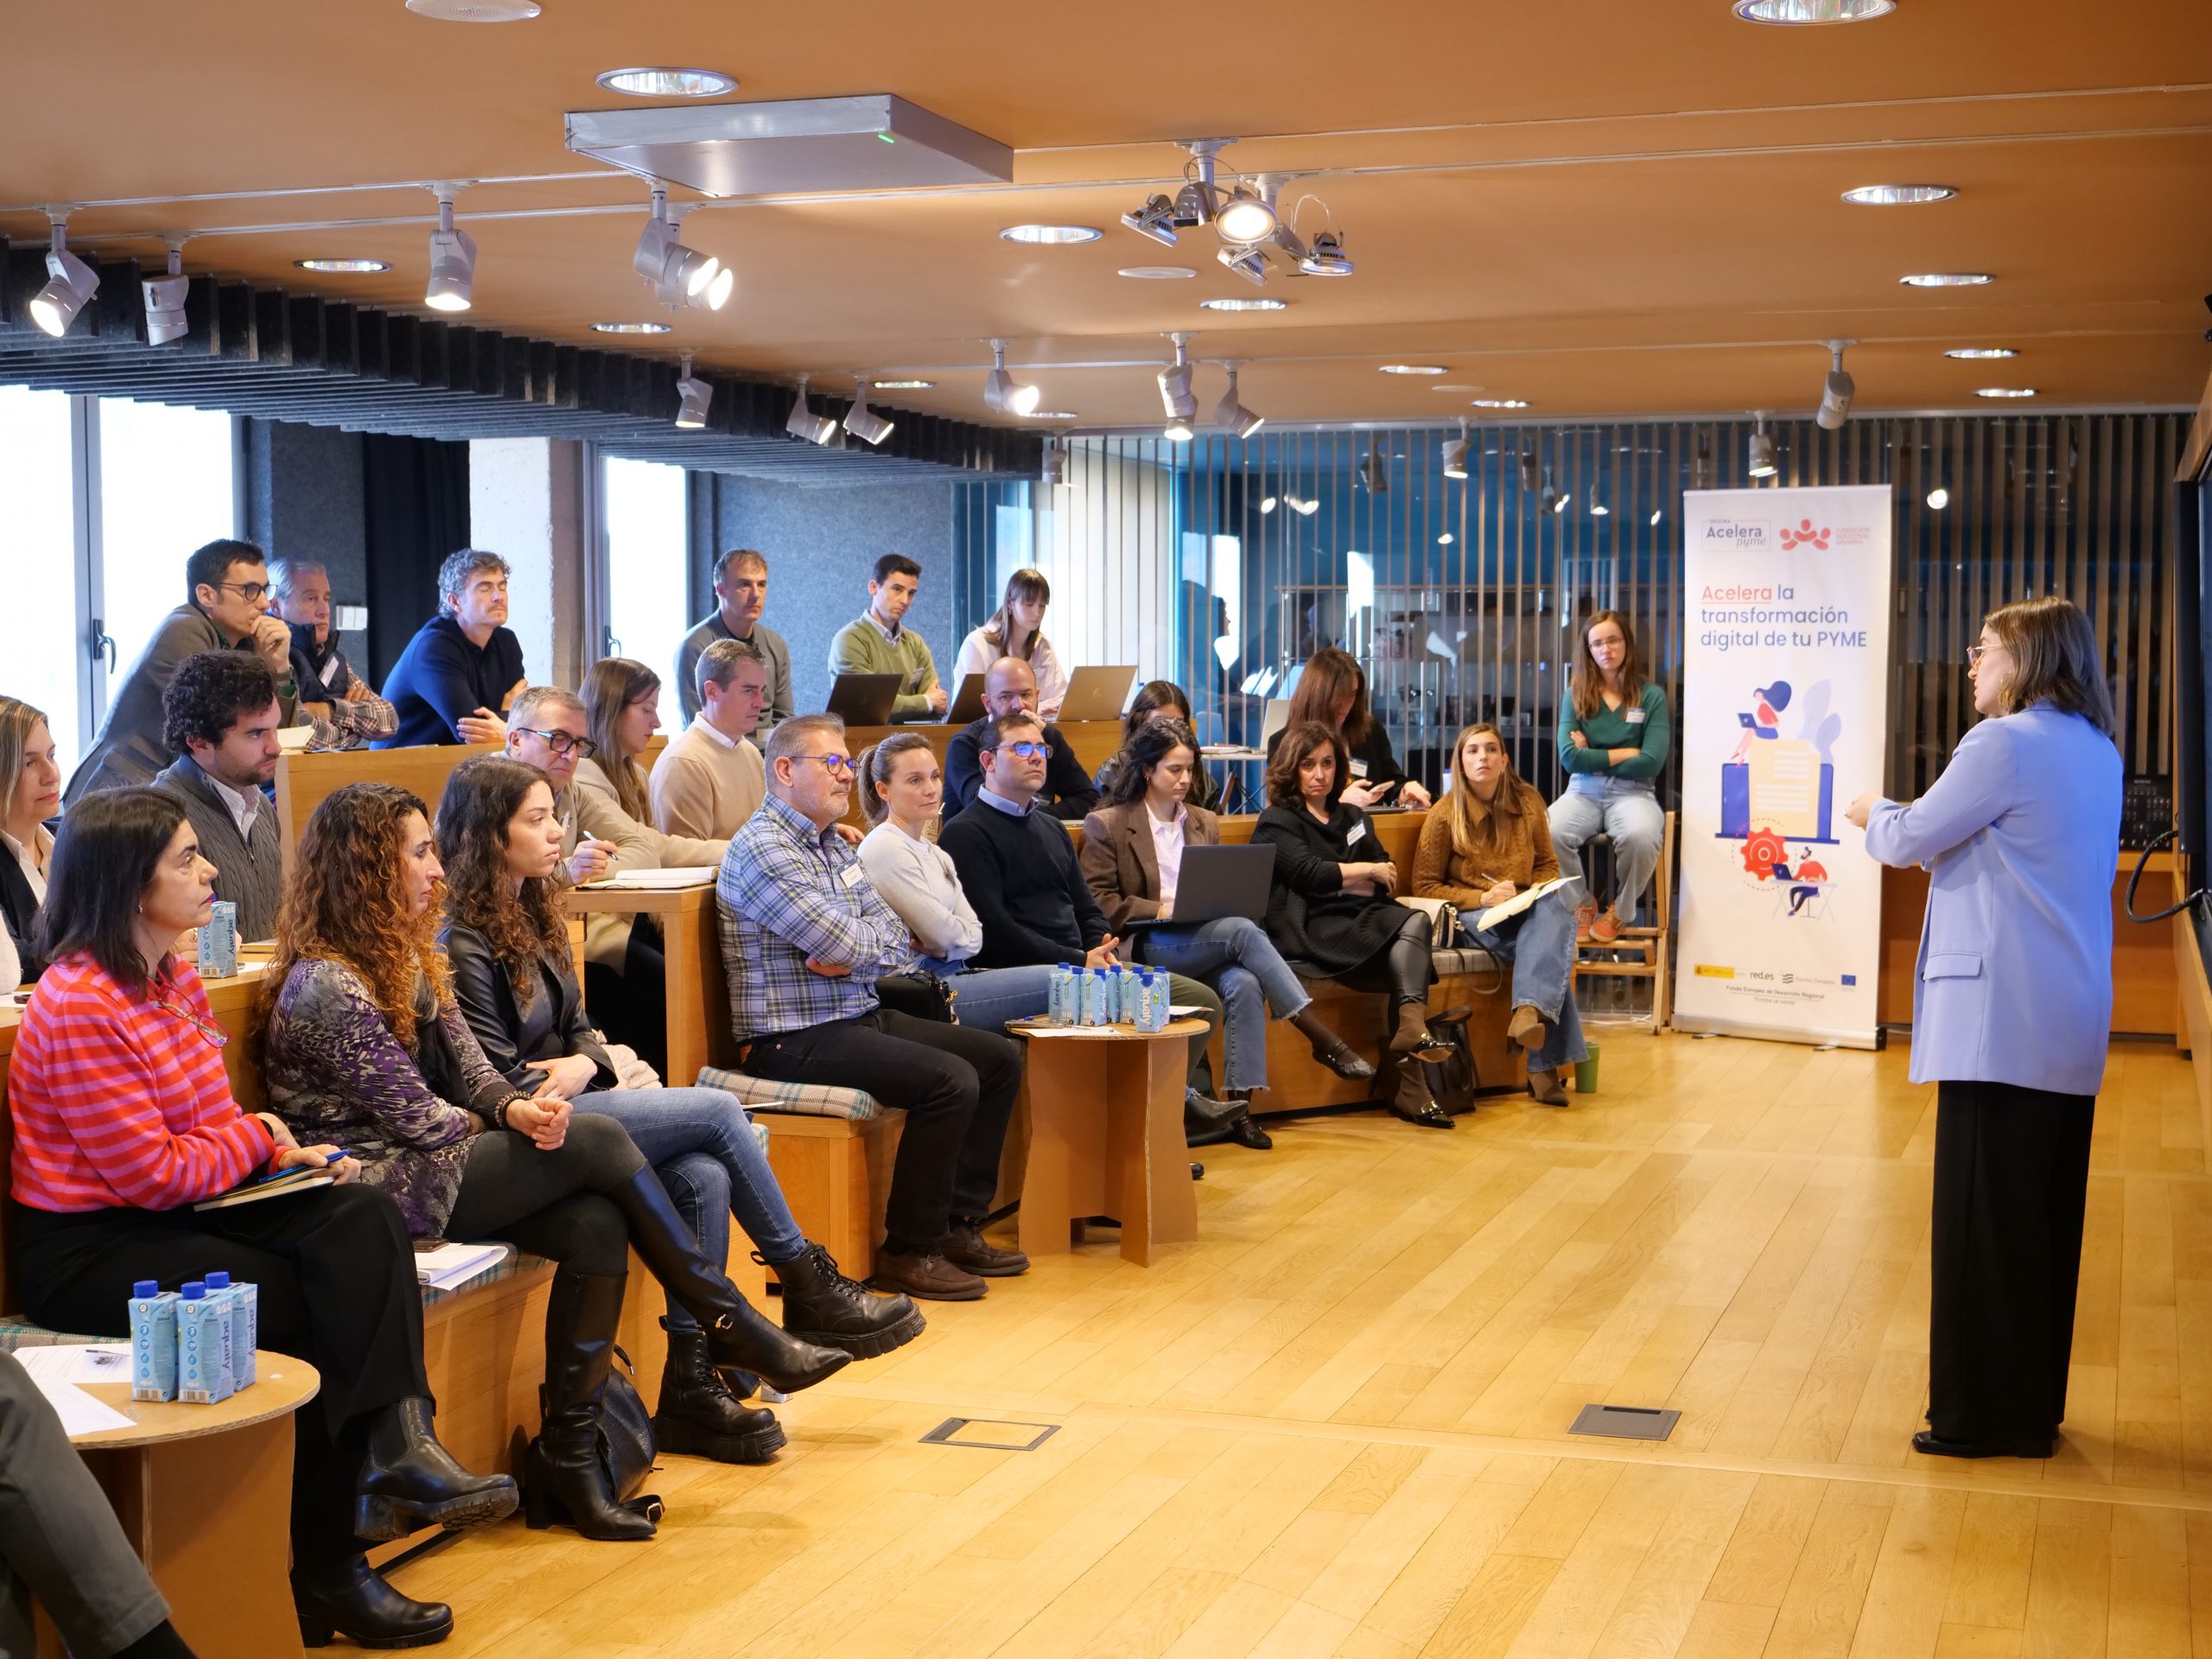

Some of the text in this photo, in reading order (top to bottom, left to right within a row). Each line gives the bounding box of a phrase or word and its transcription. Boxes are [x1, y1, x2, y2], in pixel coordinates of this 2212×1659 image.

[1707, 524, 1762, 538] Acelera
[1736, 537, 1766, 549] pyme
[1701, 584, 1794, 601] Acelera la
[1701, 606, 1848, 624] transformación
[1700, 631, 1866, 651] digital de tu PYME
[1750, 970, 1775, 981] red.es
[1139, 988, 1151, 1026] aqualy
[221, 1320, 231, 1370] aqualy
